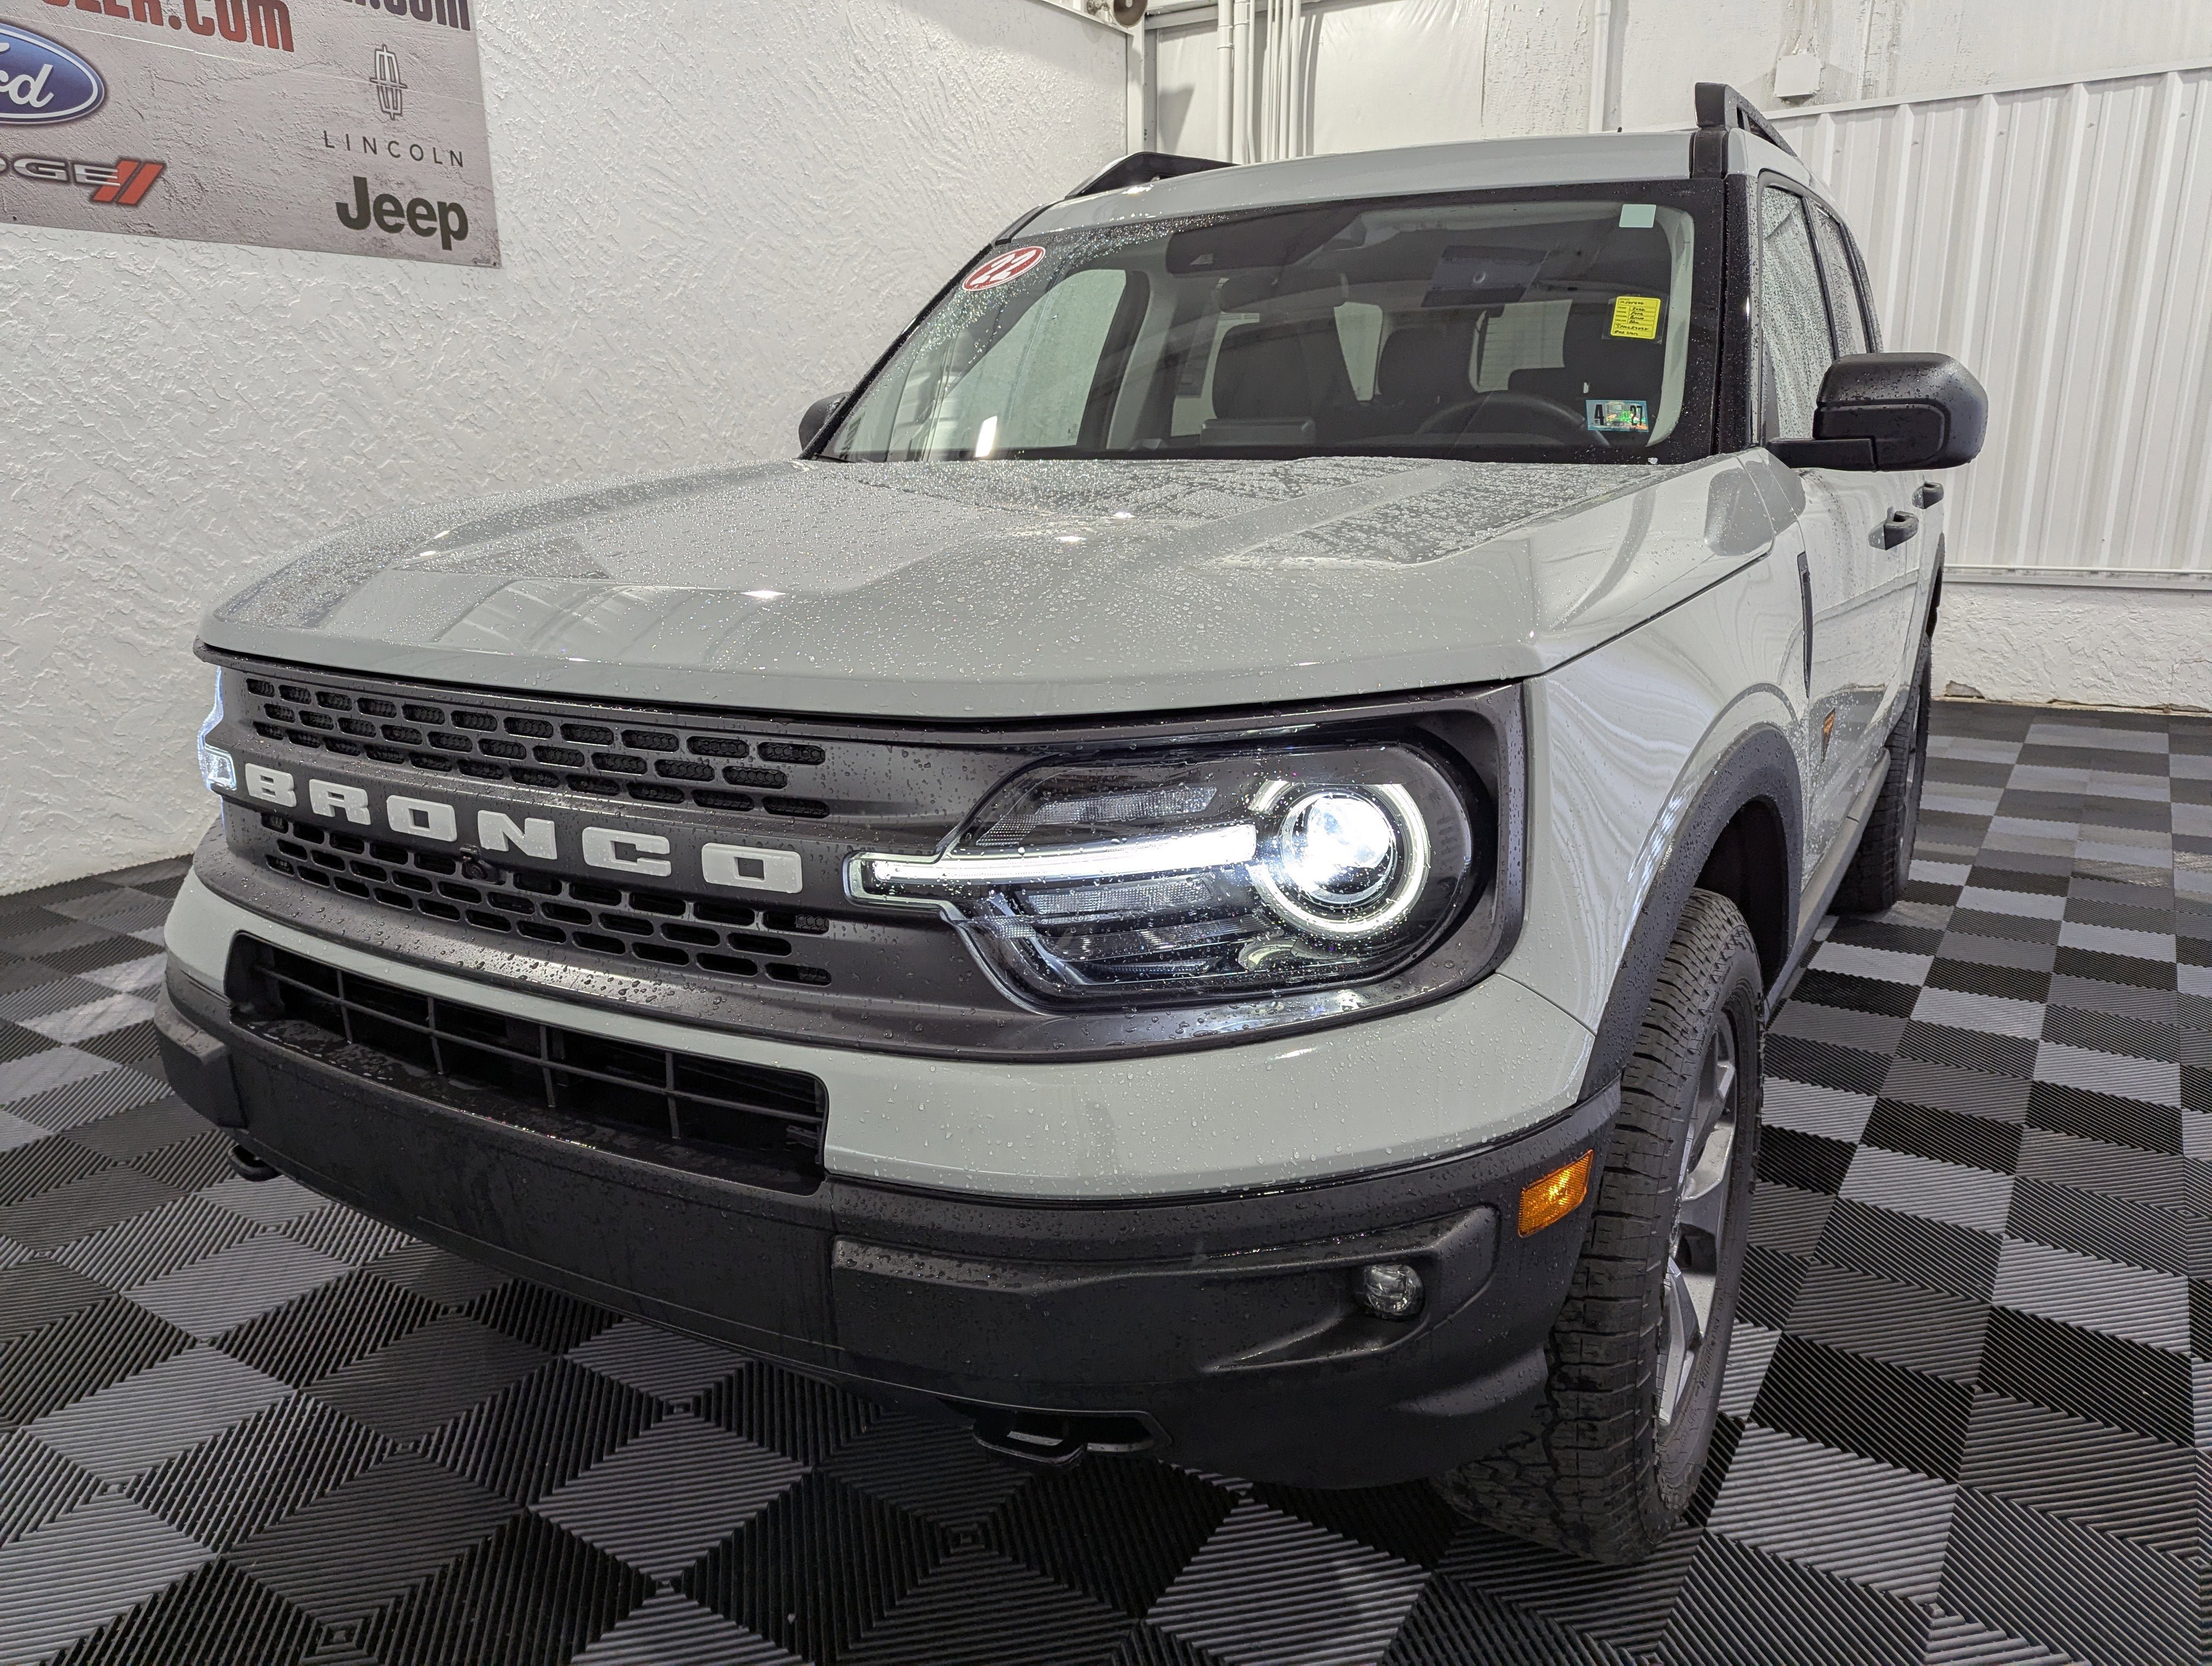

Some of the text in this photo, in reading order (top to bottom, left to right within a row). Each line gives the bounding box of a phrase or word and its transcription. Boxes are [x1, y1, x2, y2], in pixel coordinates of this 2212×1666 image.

[324, 130, 463, 168] LINCOLN
[336, 176, 468, 251] Jeep
[1594, 405, 1604, 425] 4
[1630, 406, 1643, 426] 27
[245, 763, 802, 893] BRONCO
